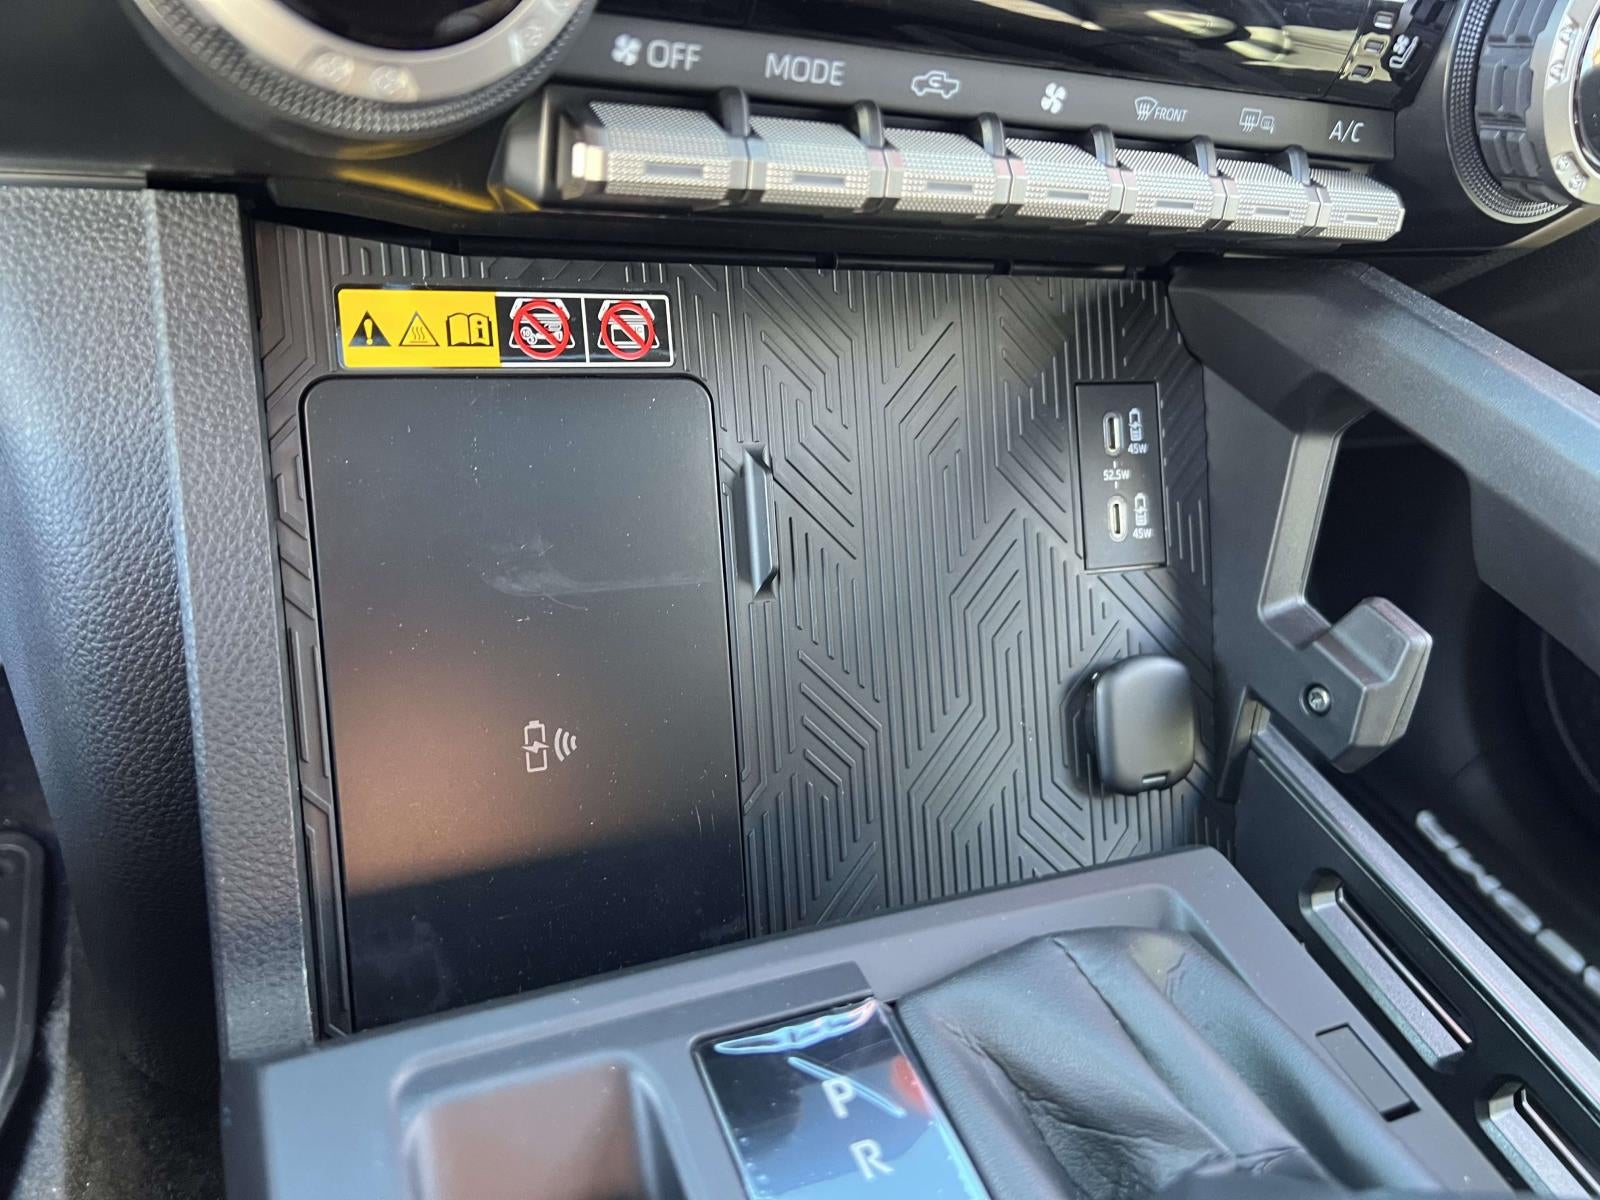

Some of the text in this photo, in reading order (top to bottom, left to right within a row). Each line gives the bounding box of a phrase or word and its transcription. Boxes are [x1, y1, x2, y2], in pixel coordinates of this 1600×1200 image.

[646, 39, 702, 71] OFF
[764, 52, 846, 87] MODE
[1153, 106, 1188, 122] FRONT
[1329, 120, 1365, 143] A/C
[1127, 443, 1148, 455] 45W
[1103, 469, 1131, 481] 52.5W
[1132, 527, 1152, 540] 45W
[821, 1075, 856, 1120] P
[849, 1138, 895, 1182] R
